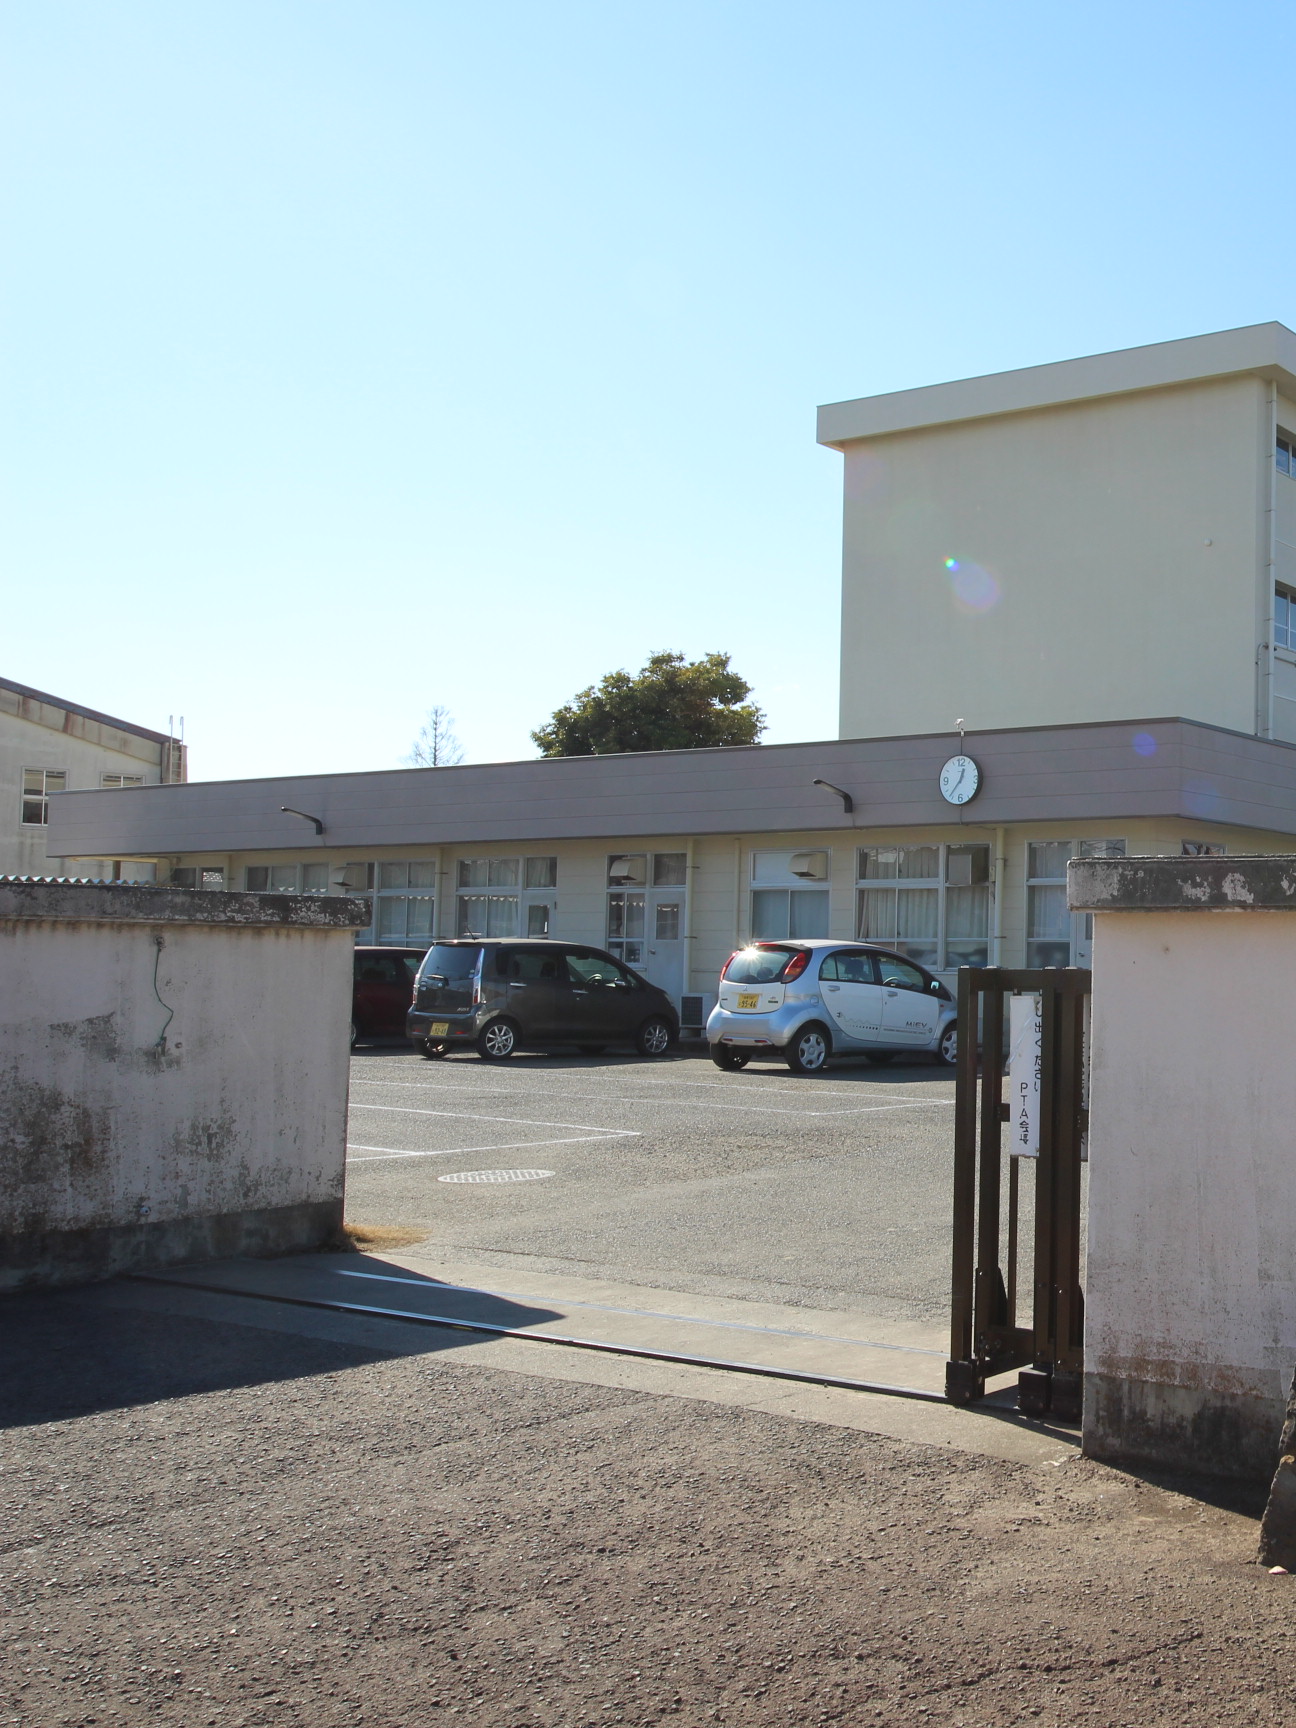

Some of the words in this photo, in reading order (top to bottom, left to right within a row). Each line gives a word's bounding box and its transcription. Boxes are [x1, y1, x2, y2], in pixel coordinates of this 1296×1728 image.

[957, 758, 966, 767] 12
[943, 777, 949, 785] 9
[958, 794, 964, 802] 6
